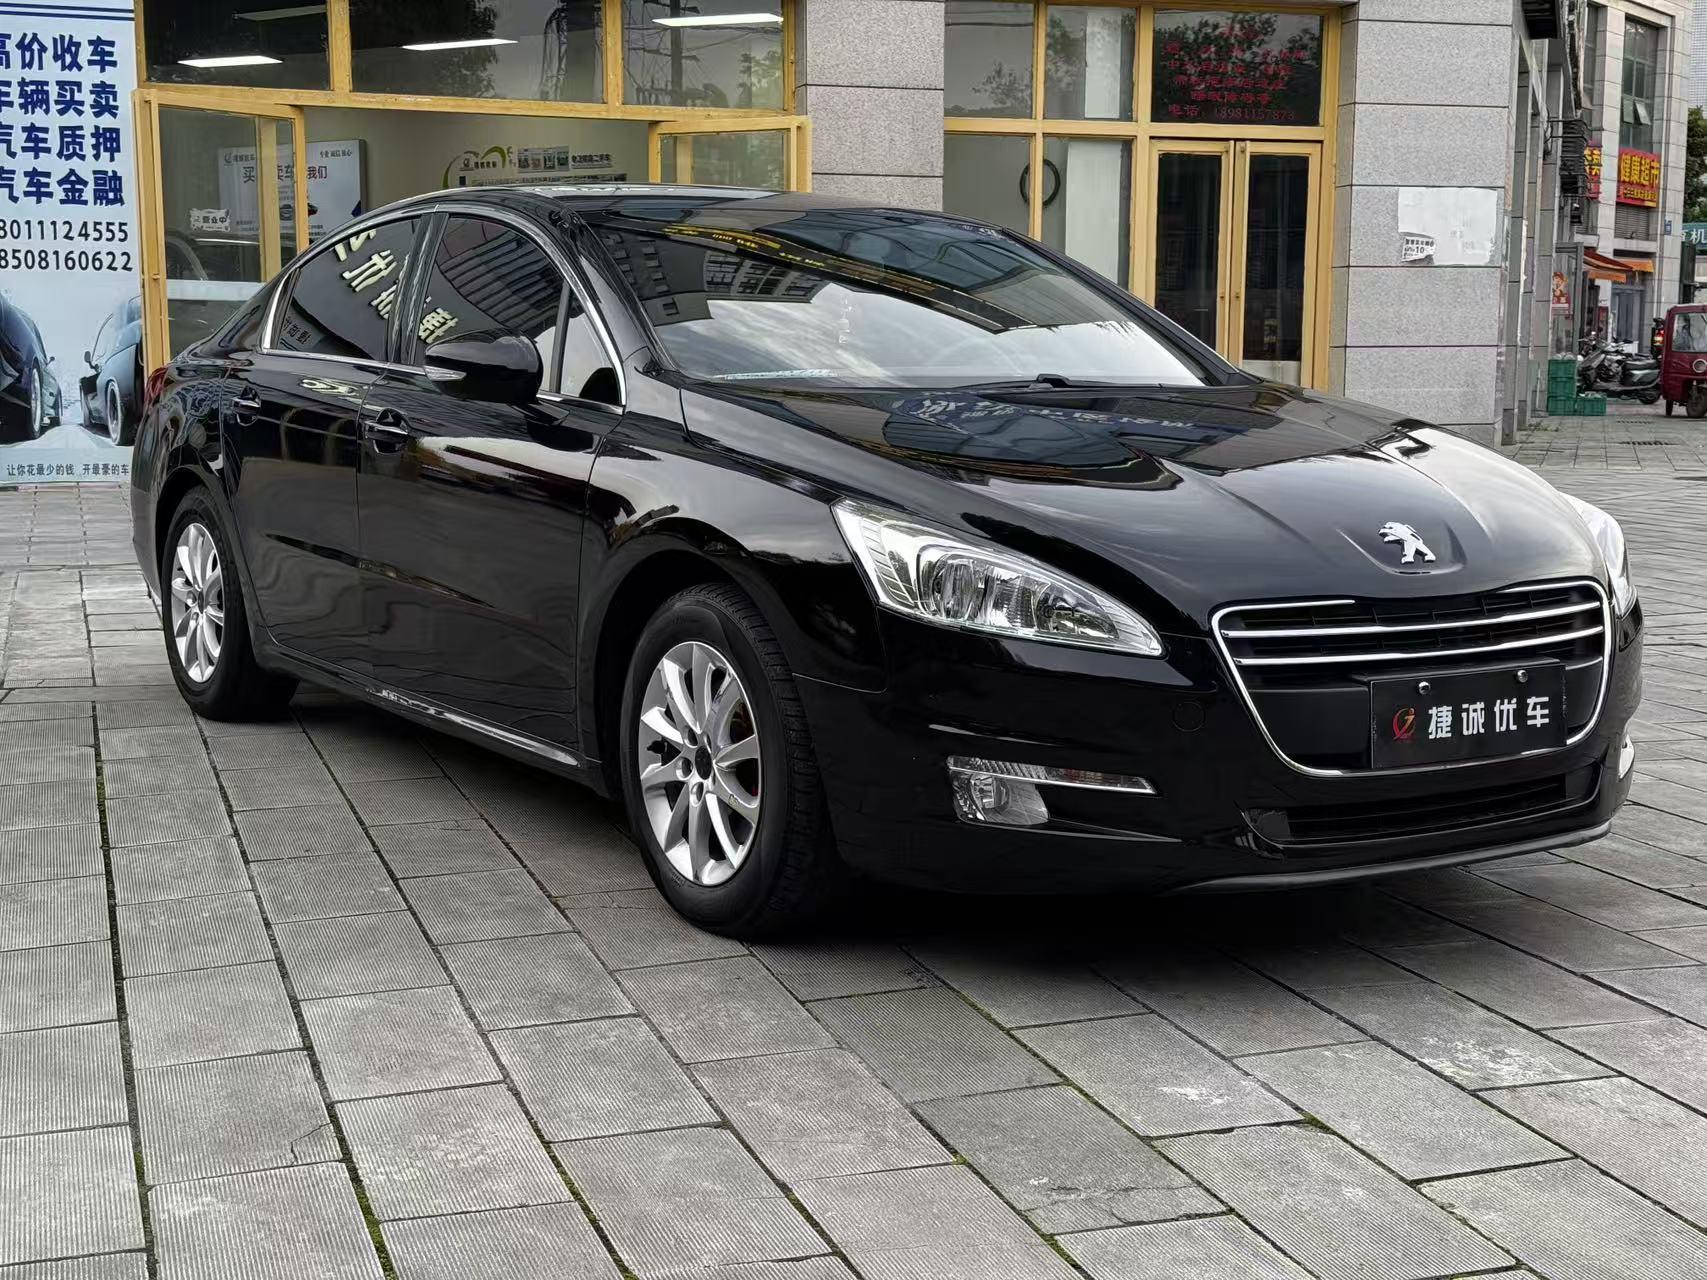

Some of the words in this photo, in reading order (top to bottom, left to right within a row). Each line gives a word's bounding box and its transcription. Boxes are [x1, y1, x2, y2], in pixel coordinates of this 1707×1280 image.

[0, 249, 133, 272] 8508160622
[6, 463, 75, 477] 让你花最少的钱
[82, 463, 130, 476] 开最豪的车
[1428, 696, 1550, 739] 捷诚优车
